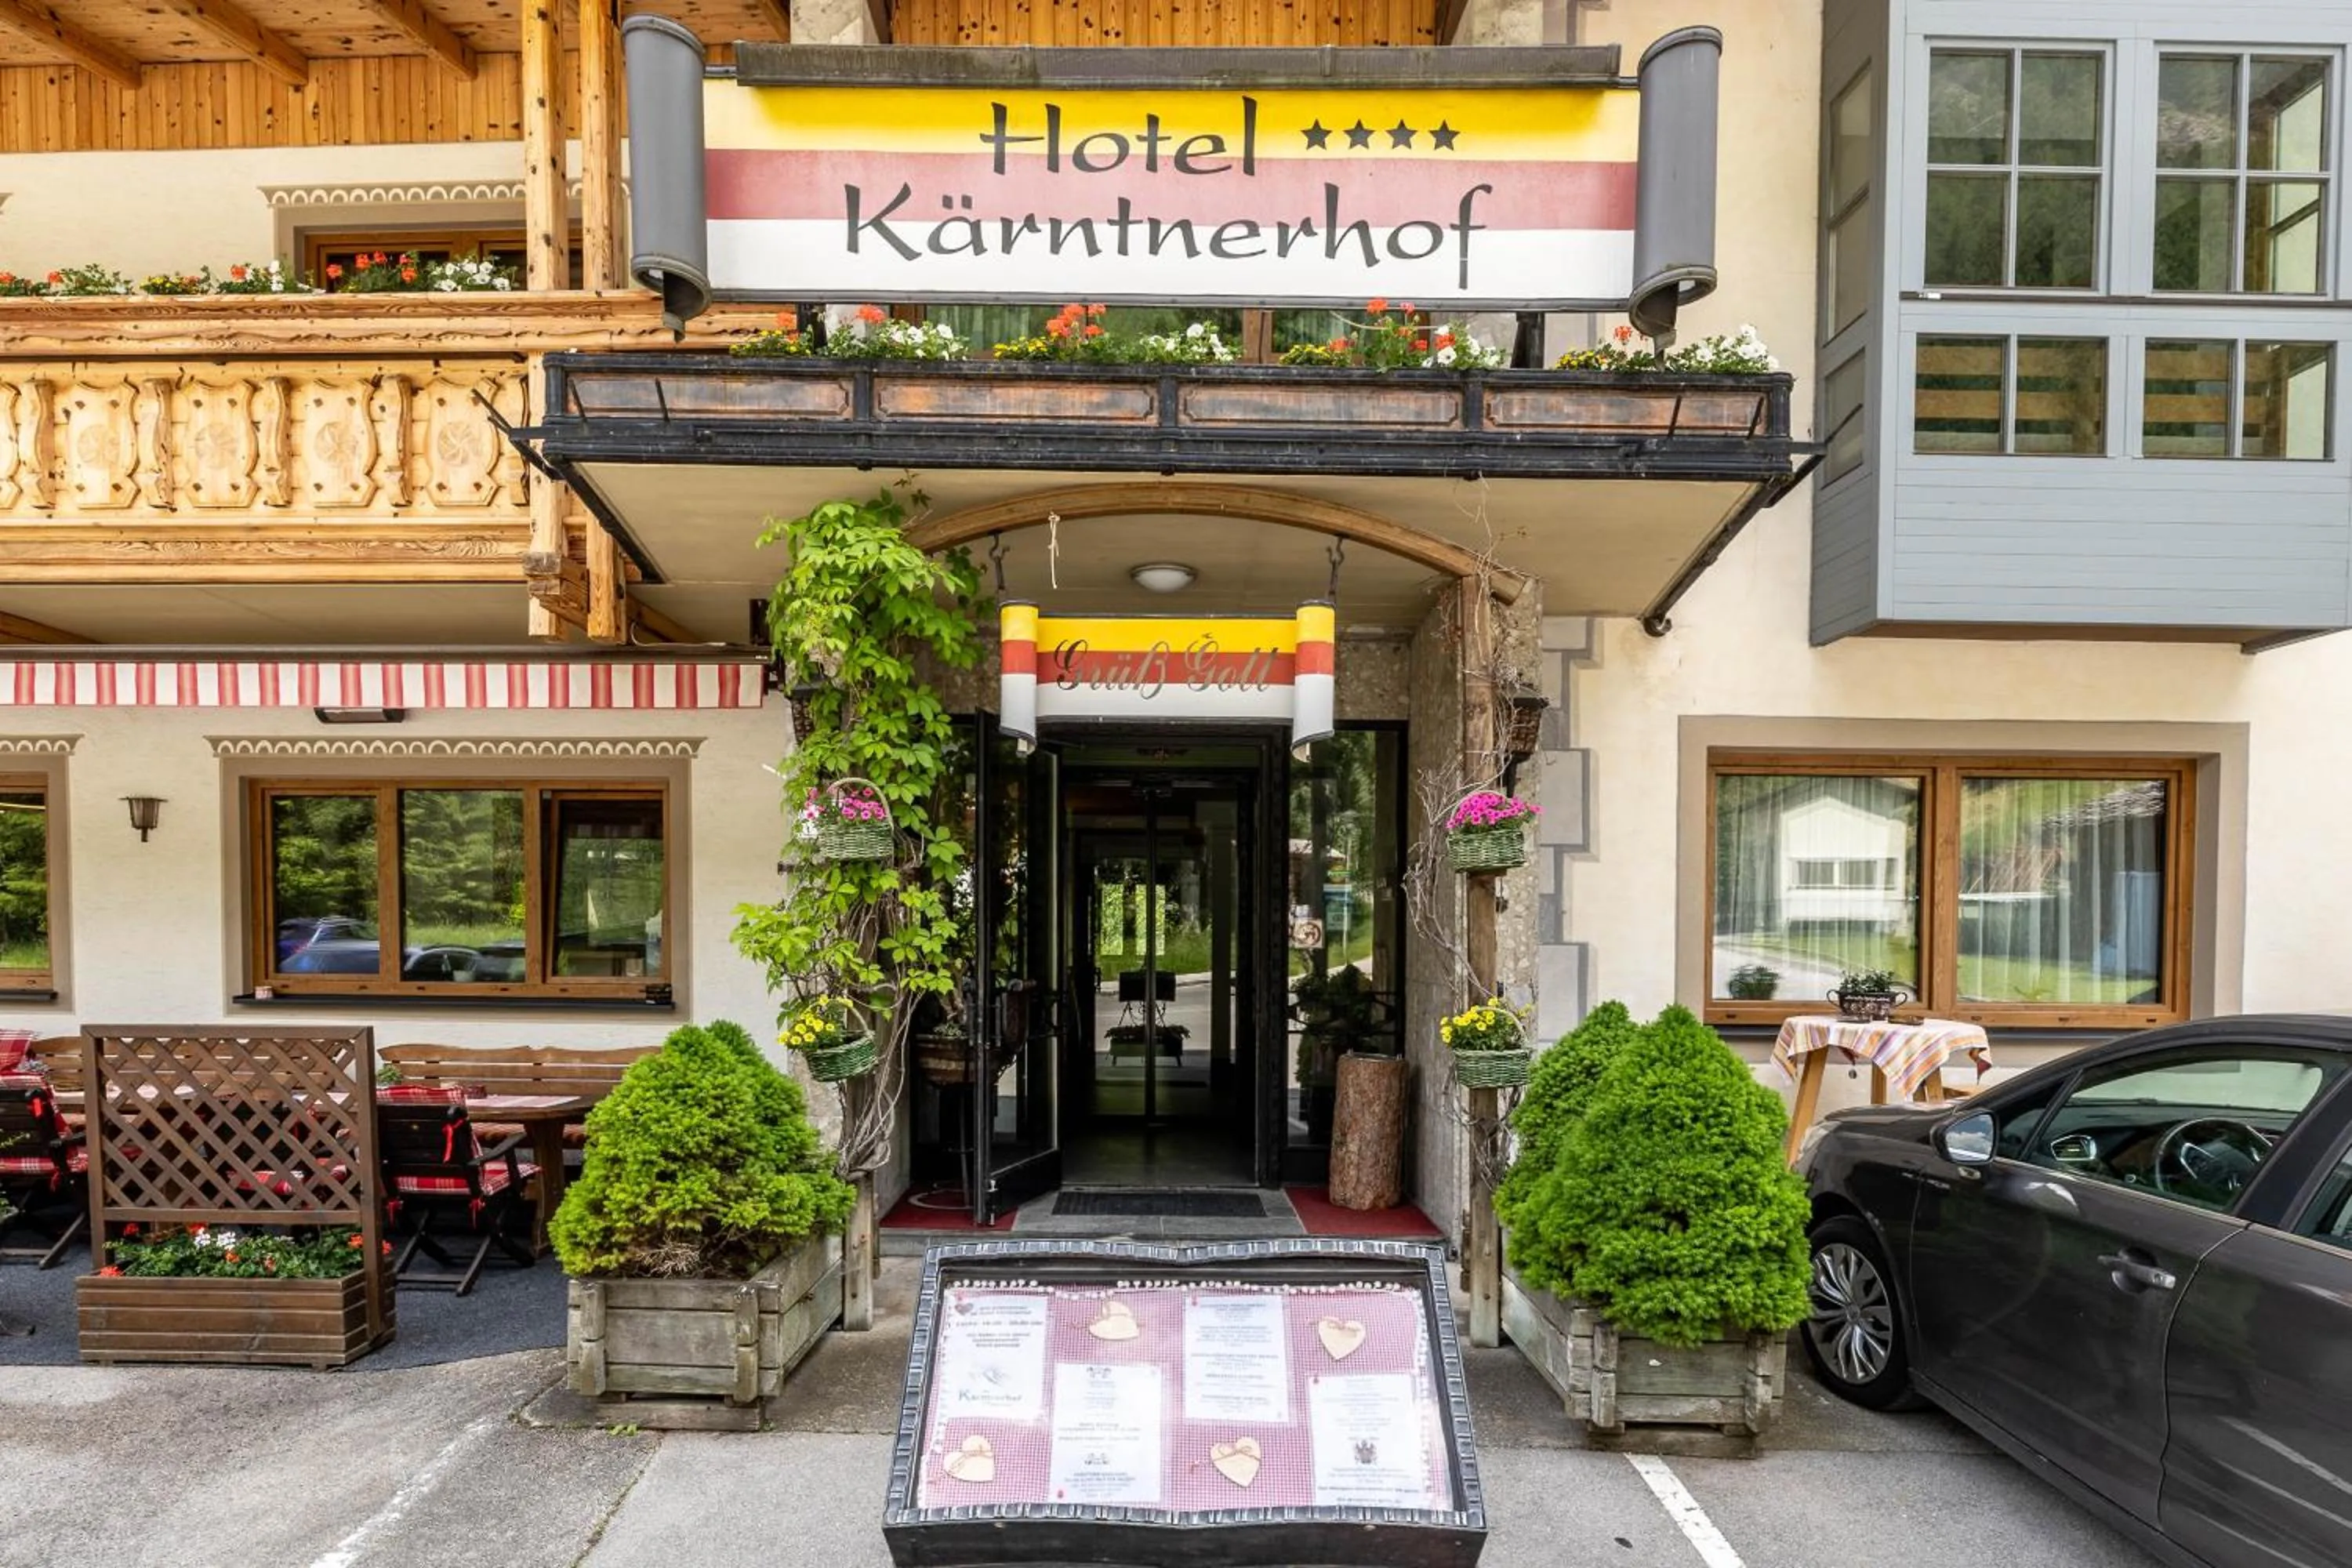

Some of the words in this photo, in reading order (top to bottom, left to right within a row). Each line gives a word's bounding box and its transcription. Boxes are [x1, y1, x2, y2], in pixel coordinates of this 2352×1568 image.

[979, 95, 1256, 176] Hotel
[842, 182, 1494, 290] Kärntnerhof
[1054, 638, 1167, 700] Grüß
[1184, 633, 1279, 693] Gott
